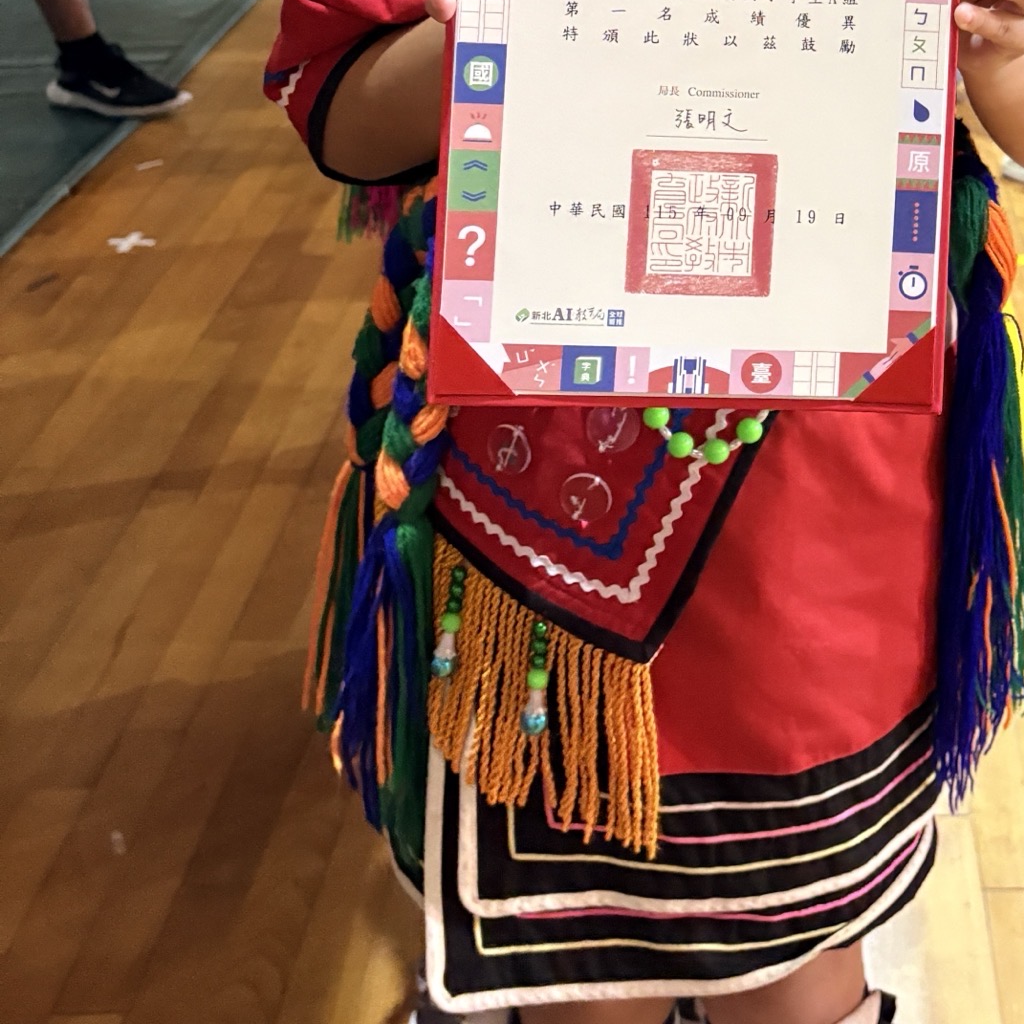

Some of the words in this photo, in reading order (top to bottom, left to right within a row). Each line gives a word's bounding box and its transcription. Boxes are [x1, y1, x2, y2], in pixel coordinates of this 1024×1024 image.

[468, 62, 493, 87] 國
[658, 85, 680, 97] 局長
[687, 86, 761, 99] Commissioner
[907, 151, 931, 173] 原
[549, 200, 626, 219] 中華民國
[796, 209, 816, 225] 19
[750, 361, 774, 385] 臺
